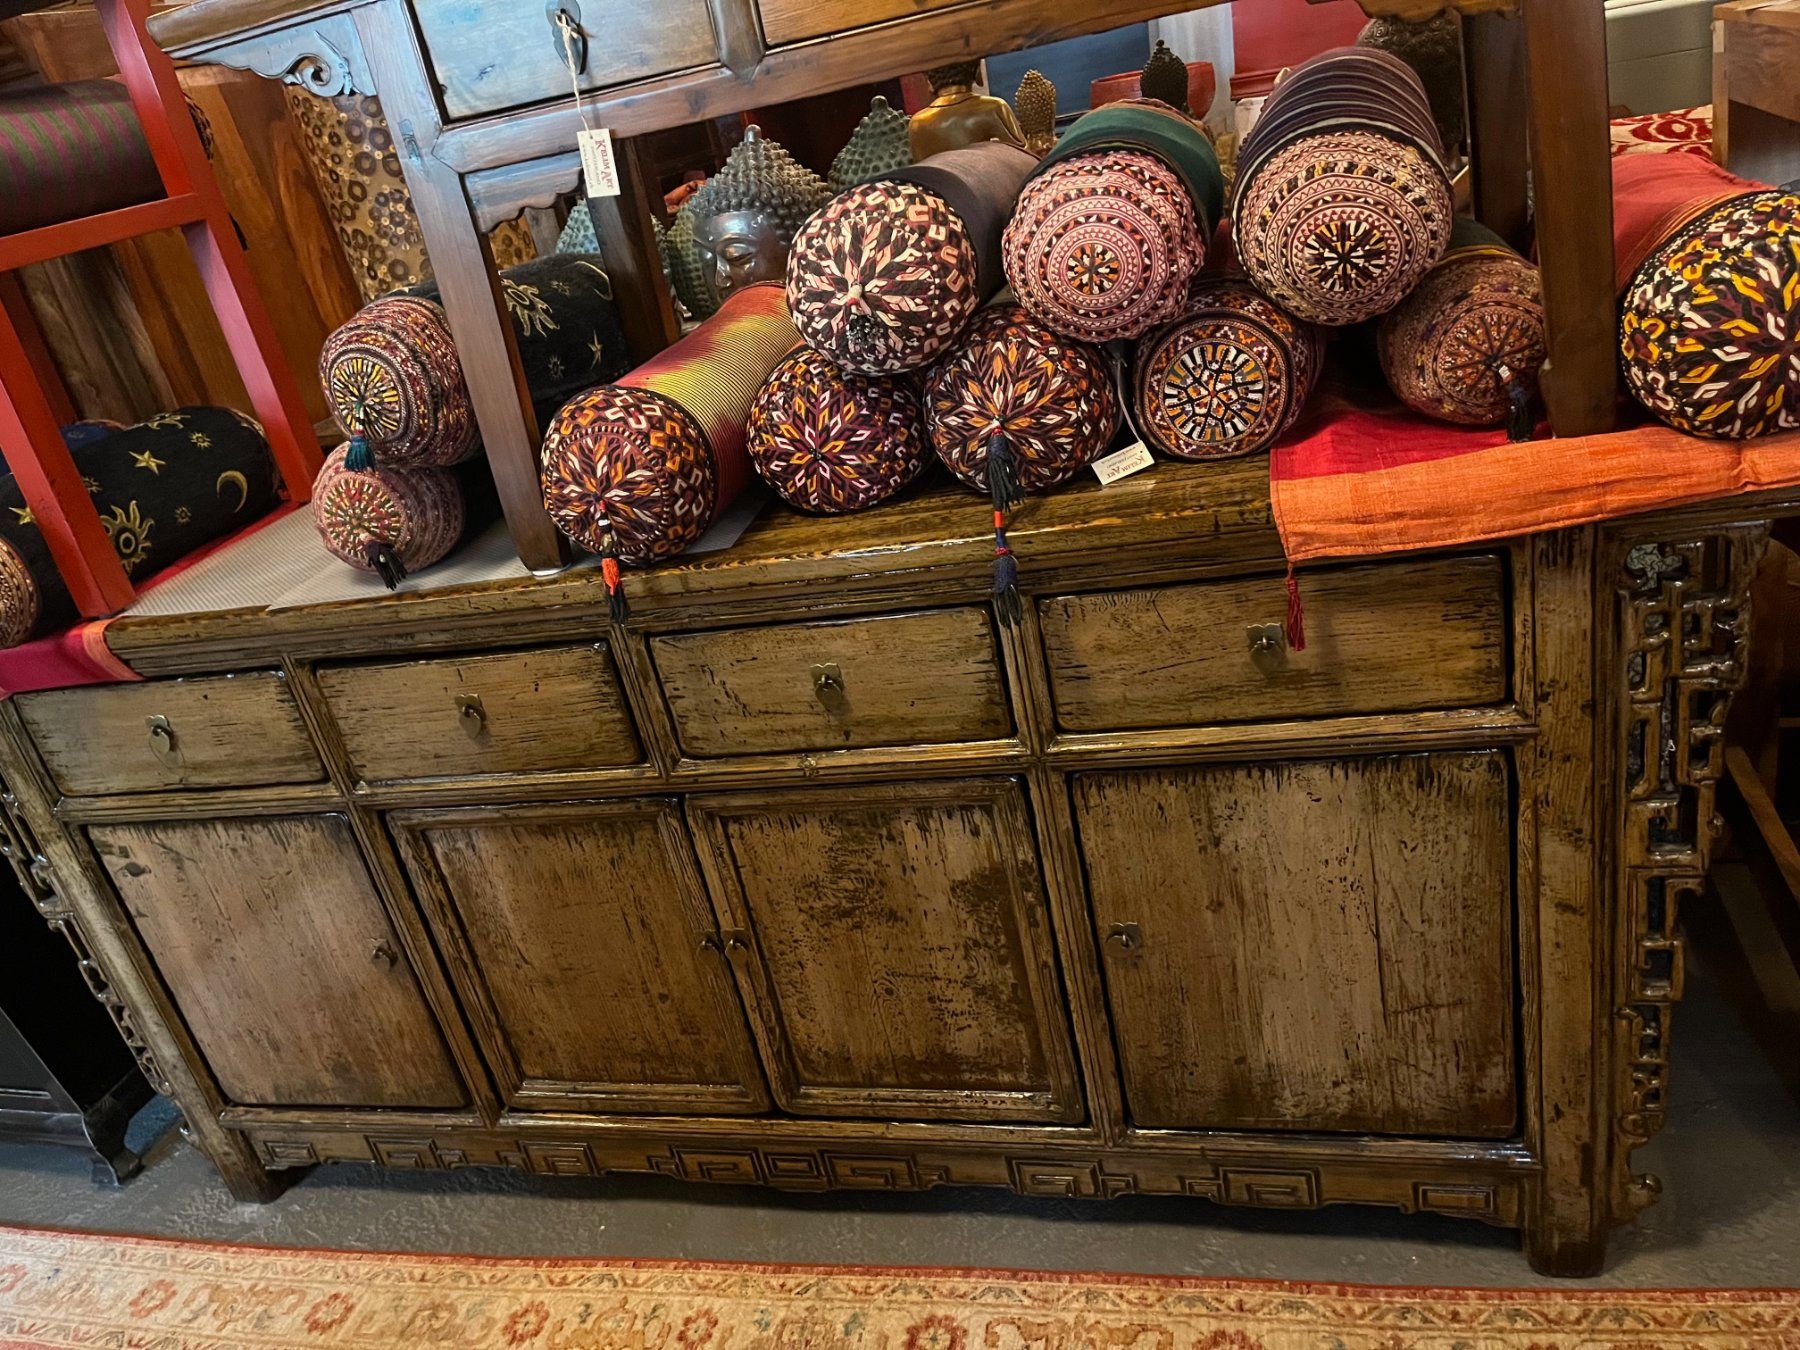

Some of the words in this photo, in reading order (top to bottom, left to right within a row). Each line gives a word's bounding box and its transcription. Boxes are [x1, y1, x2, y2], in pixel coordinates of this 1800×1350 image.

[595, 139, 610, 170] KELIM
[601, 170, 614, 189] ART
[1107, 465, 1120, 479] ART
[1121, 455, 1146, 472] KELIM
